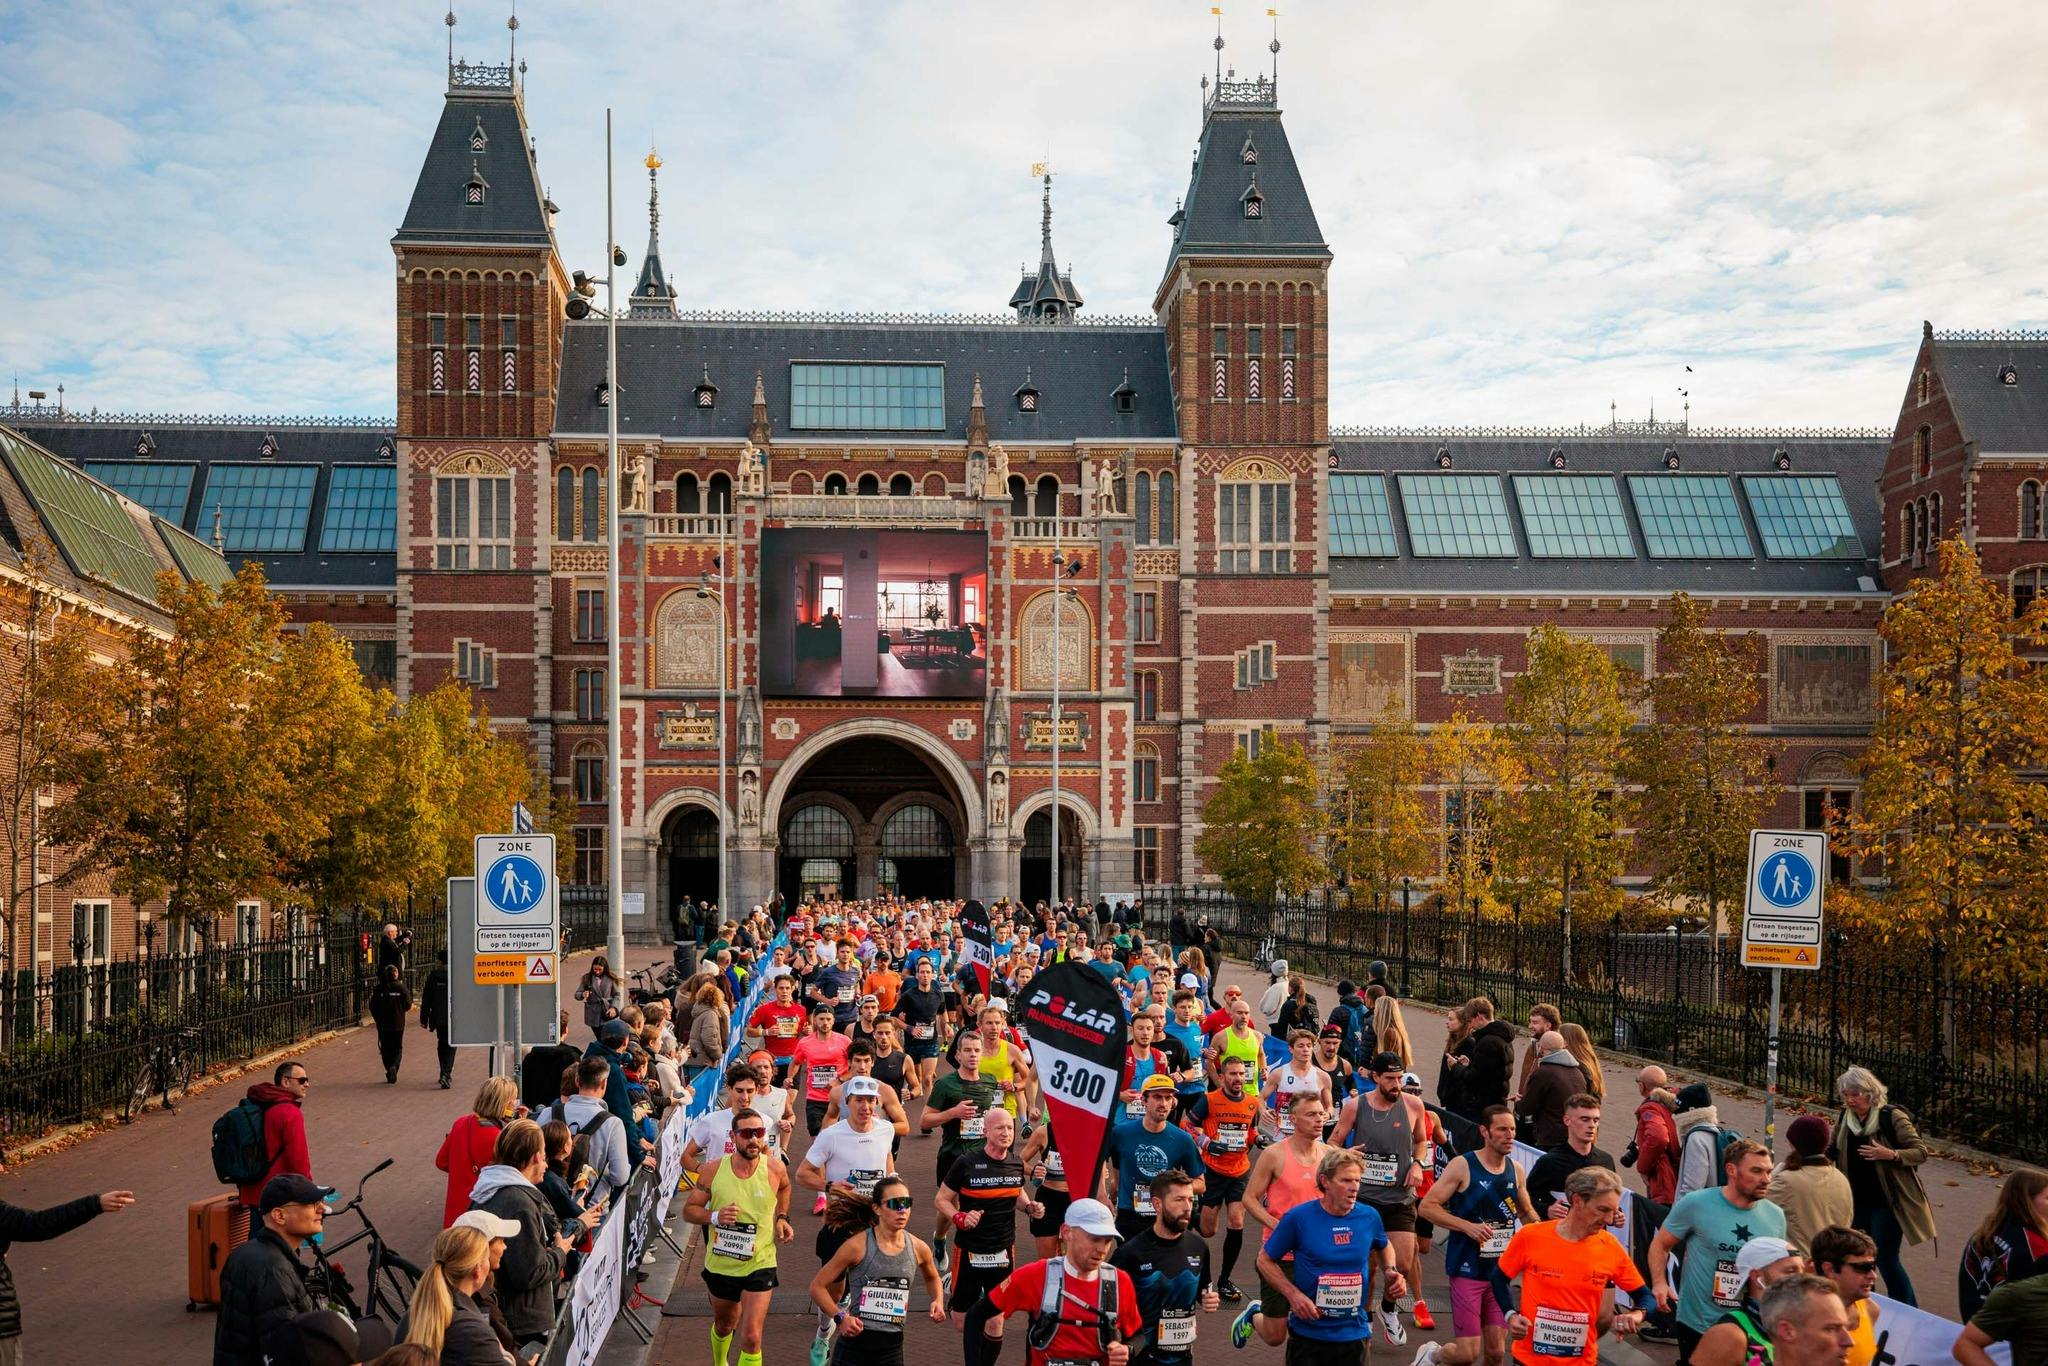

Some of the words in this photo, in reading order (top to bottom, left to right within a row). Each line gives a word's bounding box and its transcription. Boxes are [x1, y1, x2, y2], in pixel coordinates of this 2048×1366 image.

[498, 842, 532, 852] ZONE
[1773, 838, 1805, 848] ZONE
[961, 917, 988, 935] POLAR
[1752, 922, 1776, 930] fietsen
[1777, 924, 1815, 932] toegestaan
[509, 931, 550, 940] toegestaan
[1780, 932, 1806, 940] rijloper
[512, 941, 540, 949] rijloper
[477, 959, 527, 967] snorfietsers
[477, 970, 515, 978] verboden
[1029, 989, 1117, 1033] POLAR
[1049, 1059, 1106, 1105] 3:00
[1365, 1161, 1394, 1171] CAMERON
[969, 1176, 1004, 1184] HAERENS
[719, 1231, 751, 1243] KLEANTHIS
[723, 1240, 744, 1251] 20998
[867, 1290, 904, 1302] GIULIANA
[875, 1301, 894, 1310] 4453
[1325, 1297, 1355, 1306] M60030
[1162, 1308, 1175, 1318] tcs
[1540, 1321, 1583, 1335] DINGEMANSE
[1172, 1331, 1189, 1340] 1597
[1543, 1332, 1578, 1345] M50052
